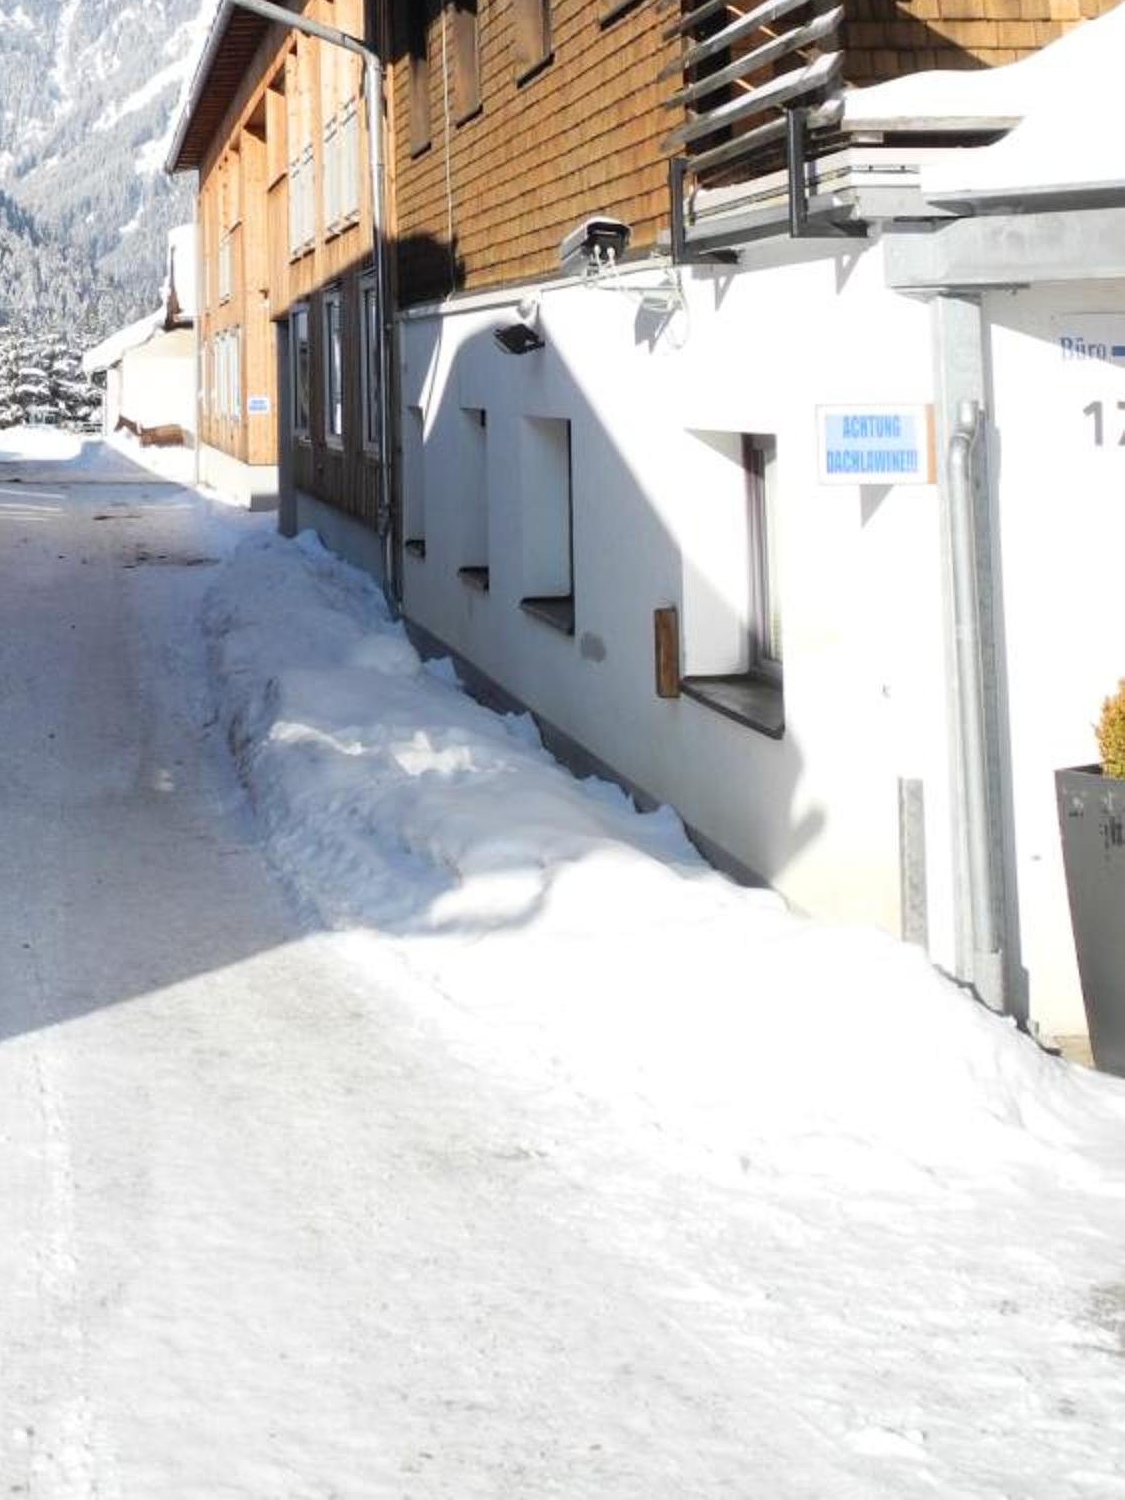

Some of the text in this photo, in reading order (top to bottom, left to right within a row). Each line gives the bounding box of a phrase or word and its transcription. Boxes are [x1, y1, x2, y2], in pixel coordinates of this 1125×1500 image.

[1059, 335, 1107, 360] Büro
[842, 414, 901, 438] ACHTUNG
[1083, 400, 1125, 447] 1
